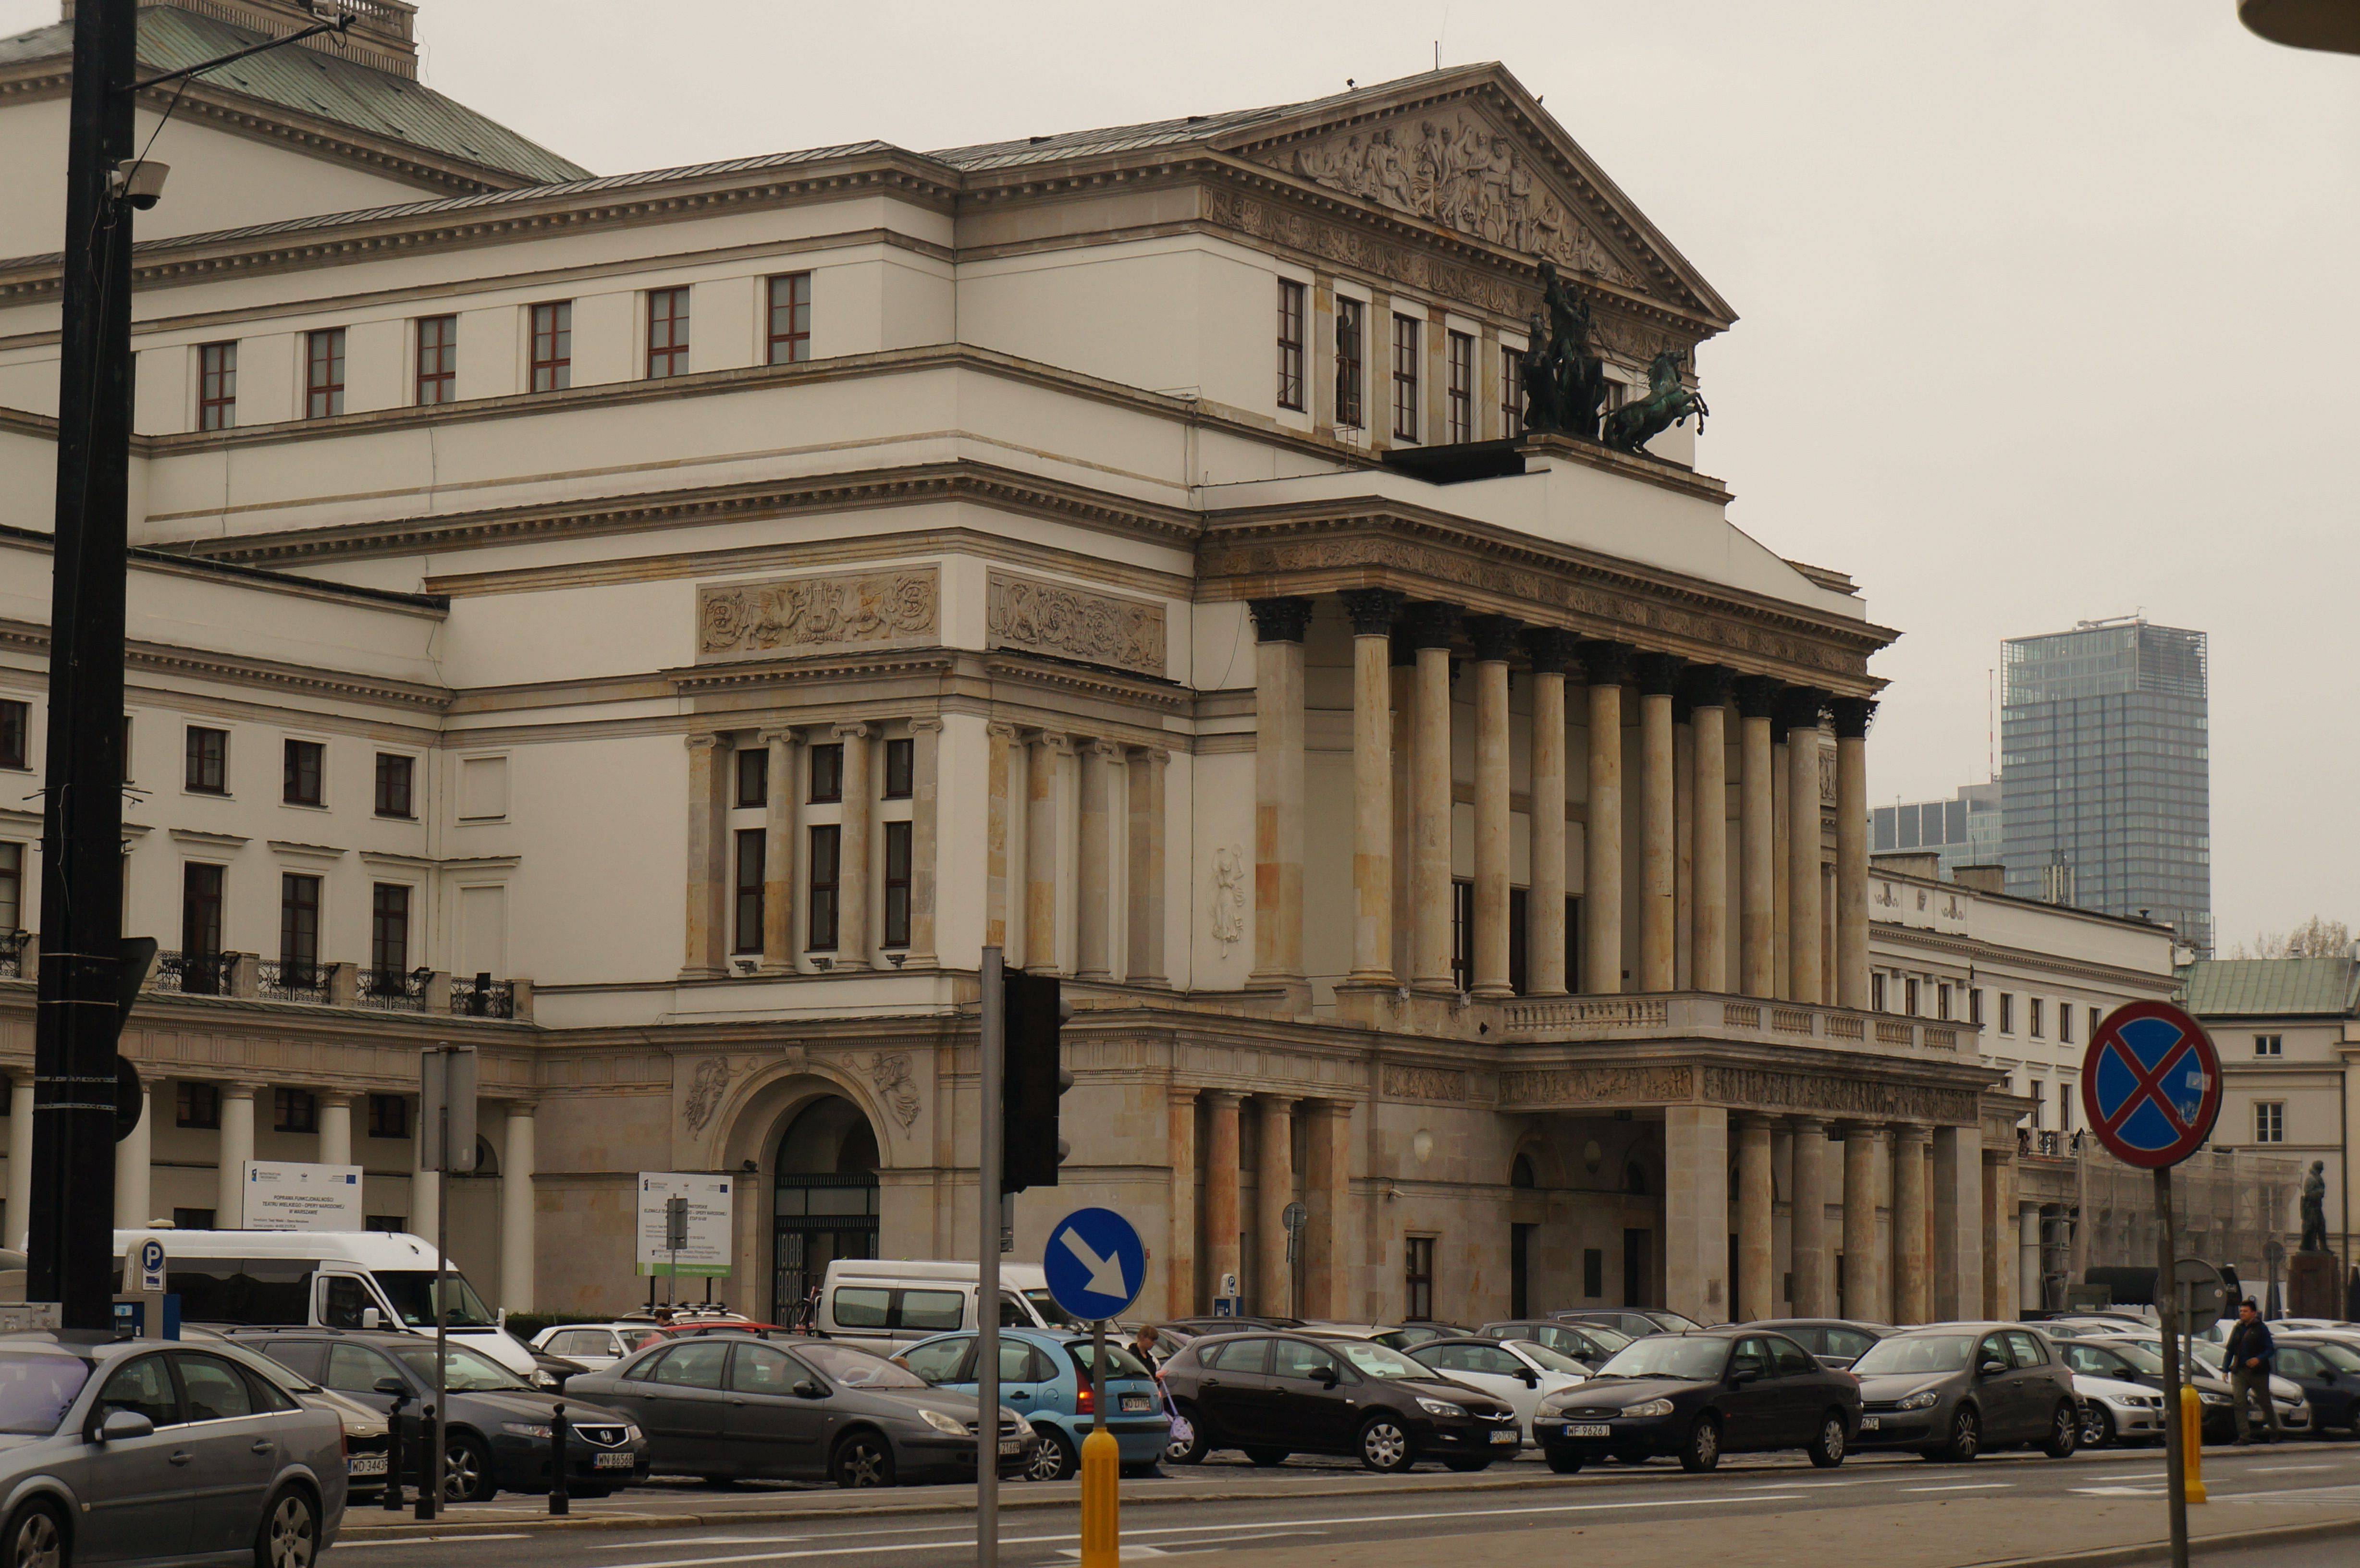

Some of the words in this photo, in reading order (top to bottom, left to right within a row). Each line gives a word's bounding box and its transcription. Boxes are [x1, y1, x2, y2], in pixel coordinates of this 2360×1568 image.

[147, 1246, 160, 1266] P
[1124, 1398, 1132, 1408] WD
[1863, 1418, 1877, 1427] 67C
[1568, 1426, 1579, 1435] WF
[1583, 1425, 1608, 1436] 9626J
[599, 1454, 610, 1465] WN
[612, 1454, 633, 1465] 86568
[353, 1460, 365, 1472] WD
